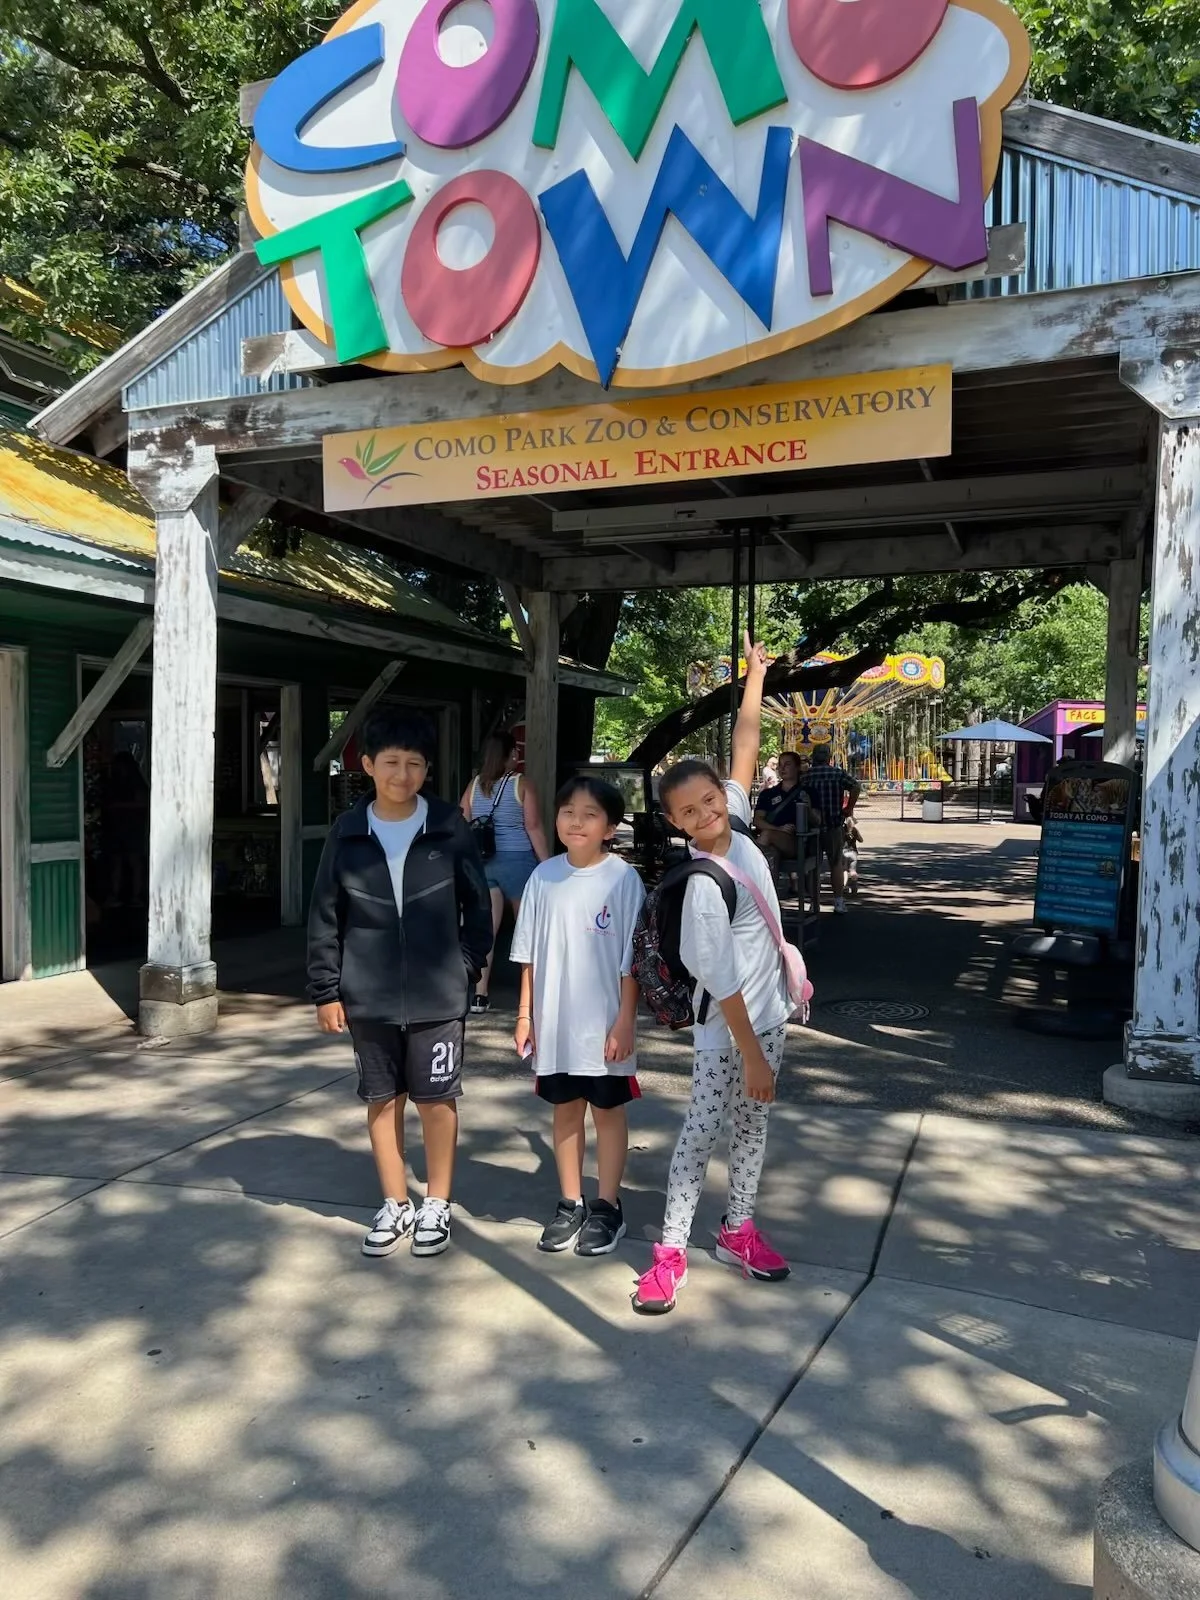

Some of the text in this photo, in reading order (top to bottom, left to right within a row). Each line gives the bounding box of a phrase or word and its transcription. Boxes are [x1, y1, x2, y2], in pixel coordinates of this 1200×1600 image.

[255, 97, 988, 390] TOWN
[414, 385, 936, 461] COMO PARK ZOO & CONSERVATORY
[476, 438, 807, 491] SEASONAL ENTRANCE
[1069, 709, 1097, 721] FACE
[1049, 812, 1109, 822] TODAY AT COMO
[431, 1041, 454, 1075] 21
